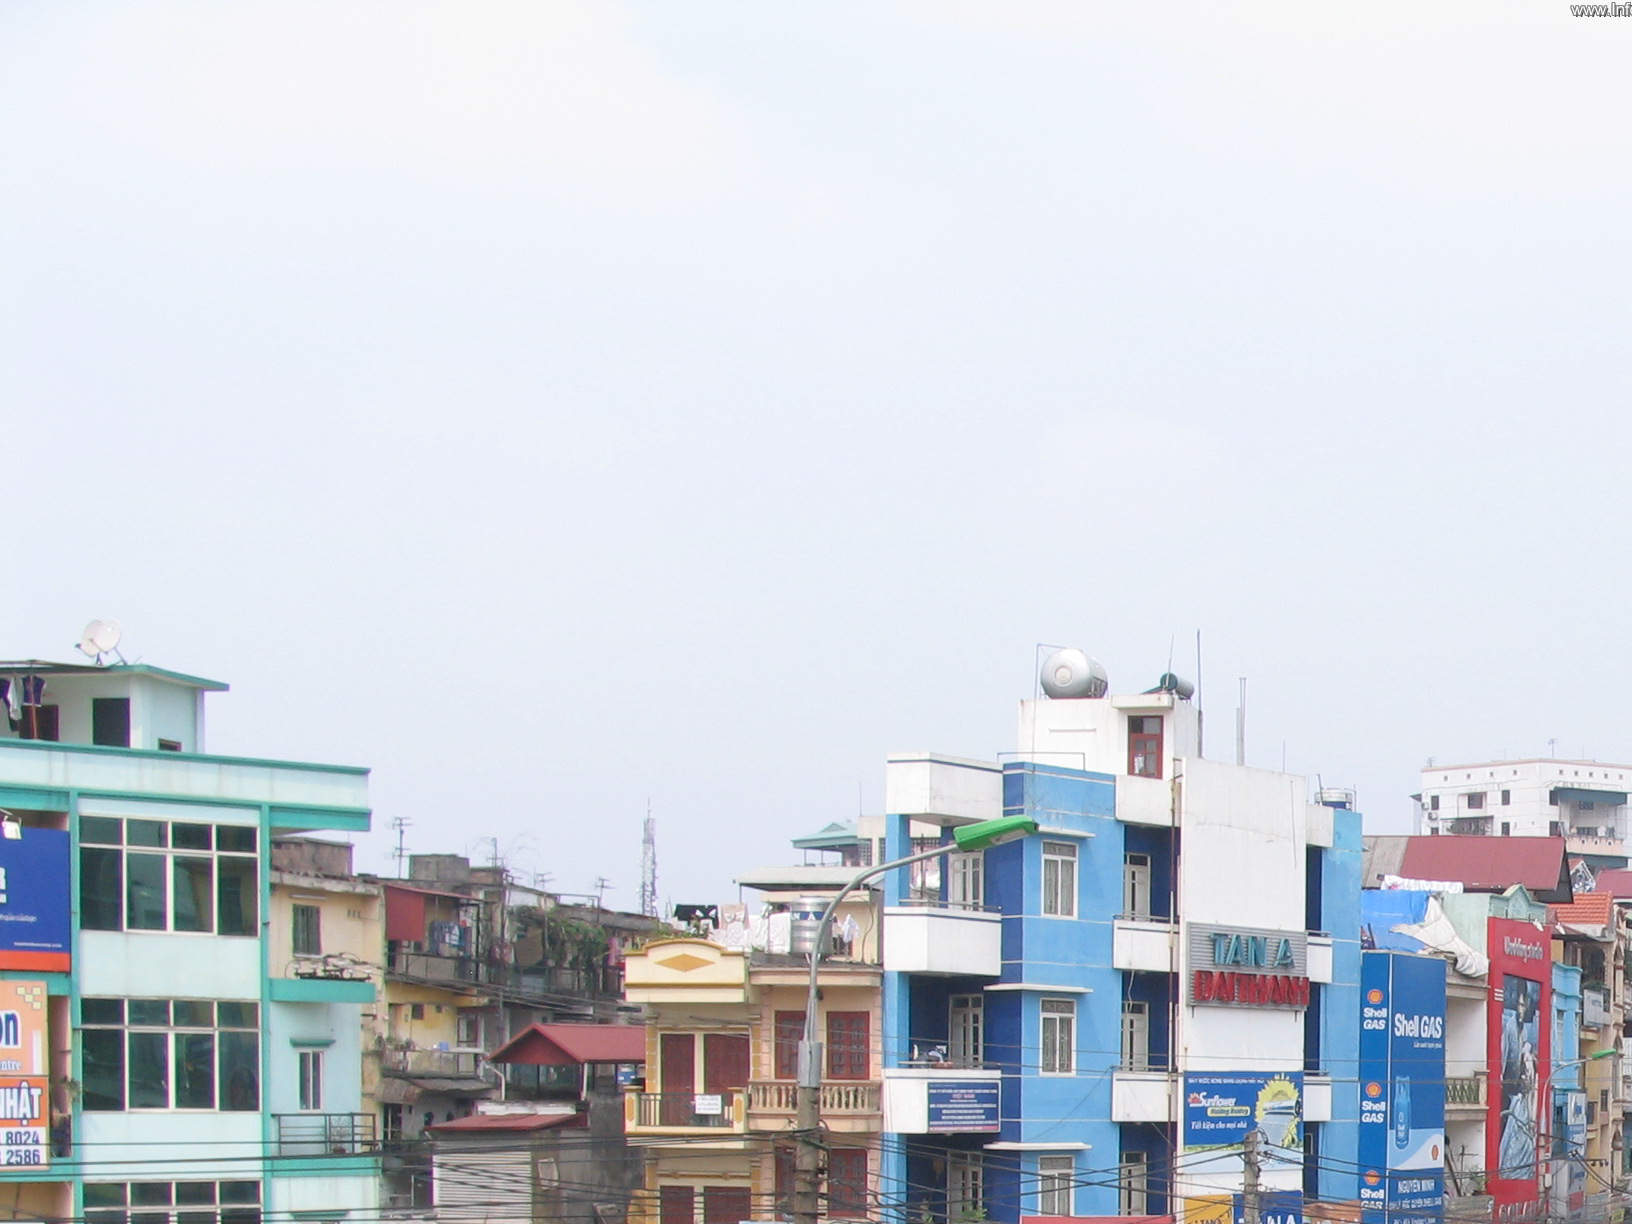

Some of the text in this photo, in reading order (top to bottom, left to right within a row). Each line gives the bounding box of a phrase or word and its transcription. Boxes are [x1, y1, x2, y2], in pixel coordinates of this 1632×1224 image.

[1363, 1008, 1387, 1018] Shell
[1363, 1019, 1386, 1030] GAS
[1394, 1013, 1442, 1039] Shell GAS
[1362, 1101, 1386, 1112] Shell
[1362, 1113, 1385, 1123] GAS
[6, 1131, 40, 1145] 8024
[6, 1150, 40, 1165] 2586
[1361, 1188, 1384, 1199] Shell
[1361, 1200, 1383, 1210] GAS
